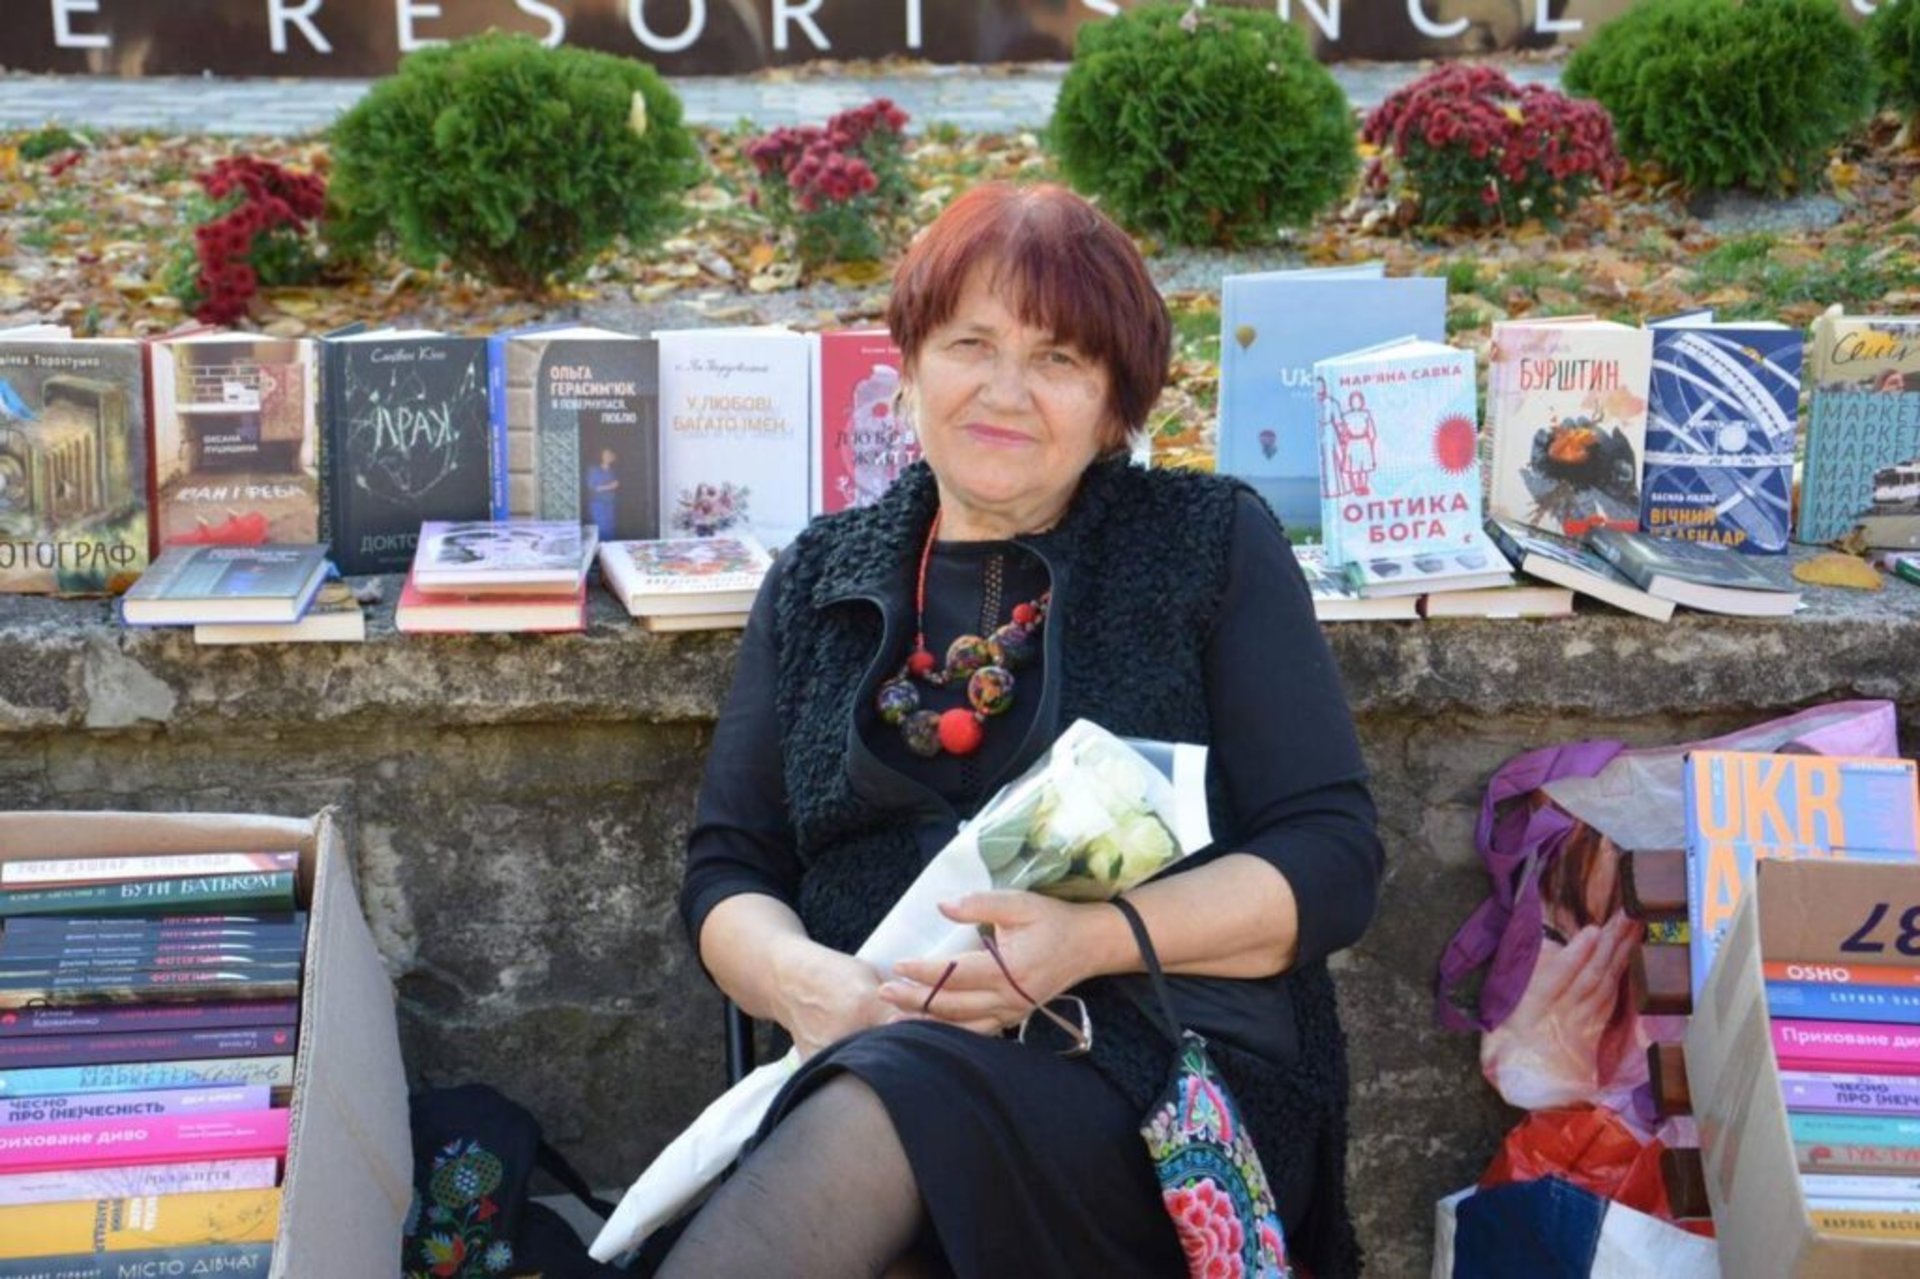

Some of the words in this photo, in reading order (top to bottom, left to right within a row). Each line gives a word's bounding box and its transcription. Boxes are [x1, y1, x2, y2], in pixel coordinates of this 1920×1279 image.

[550, 365, 593, 380] ОЛЬГА
[1411, 365, 1462, 381] САВКА
[1519, 358, 1619, 391] БУРШТИН
[551, 381, 637, 397] ГЕРАСИМ'ЮК
[673, 415, 737, 433] БАГАТО
[1343, 492, 1469, 523] ОПТИКА
[1650, 506, 1717, 526] ВІЧНИЙ
[1369, 519, 1446, 543] БОГА
[360, 533, 421, 556] ДОКТО
[1694, 752, 1844, 850] UKR
[121, 881, 170, 898] БУТИ
[181, 873, 277, 895] БАТЬКОМ
[1786, 964, 1850, 982] OSHO
[1782, 1026, 1889, 1047] Приховане
[9, 1098, 68, 1110] ЧЕСНО
[1837, 1092, 1871, 1104] ПРО
[9, 1110, 45, 1122] ПРО
[97, 1129, 149, 1145] диво
[118, 1259, 185, 1279] МІСТО
[191, 1253, 260, 1274] ДІВЧАТ
